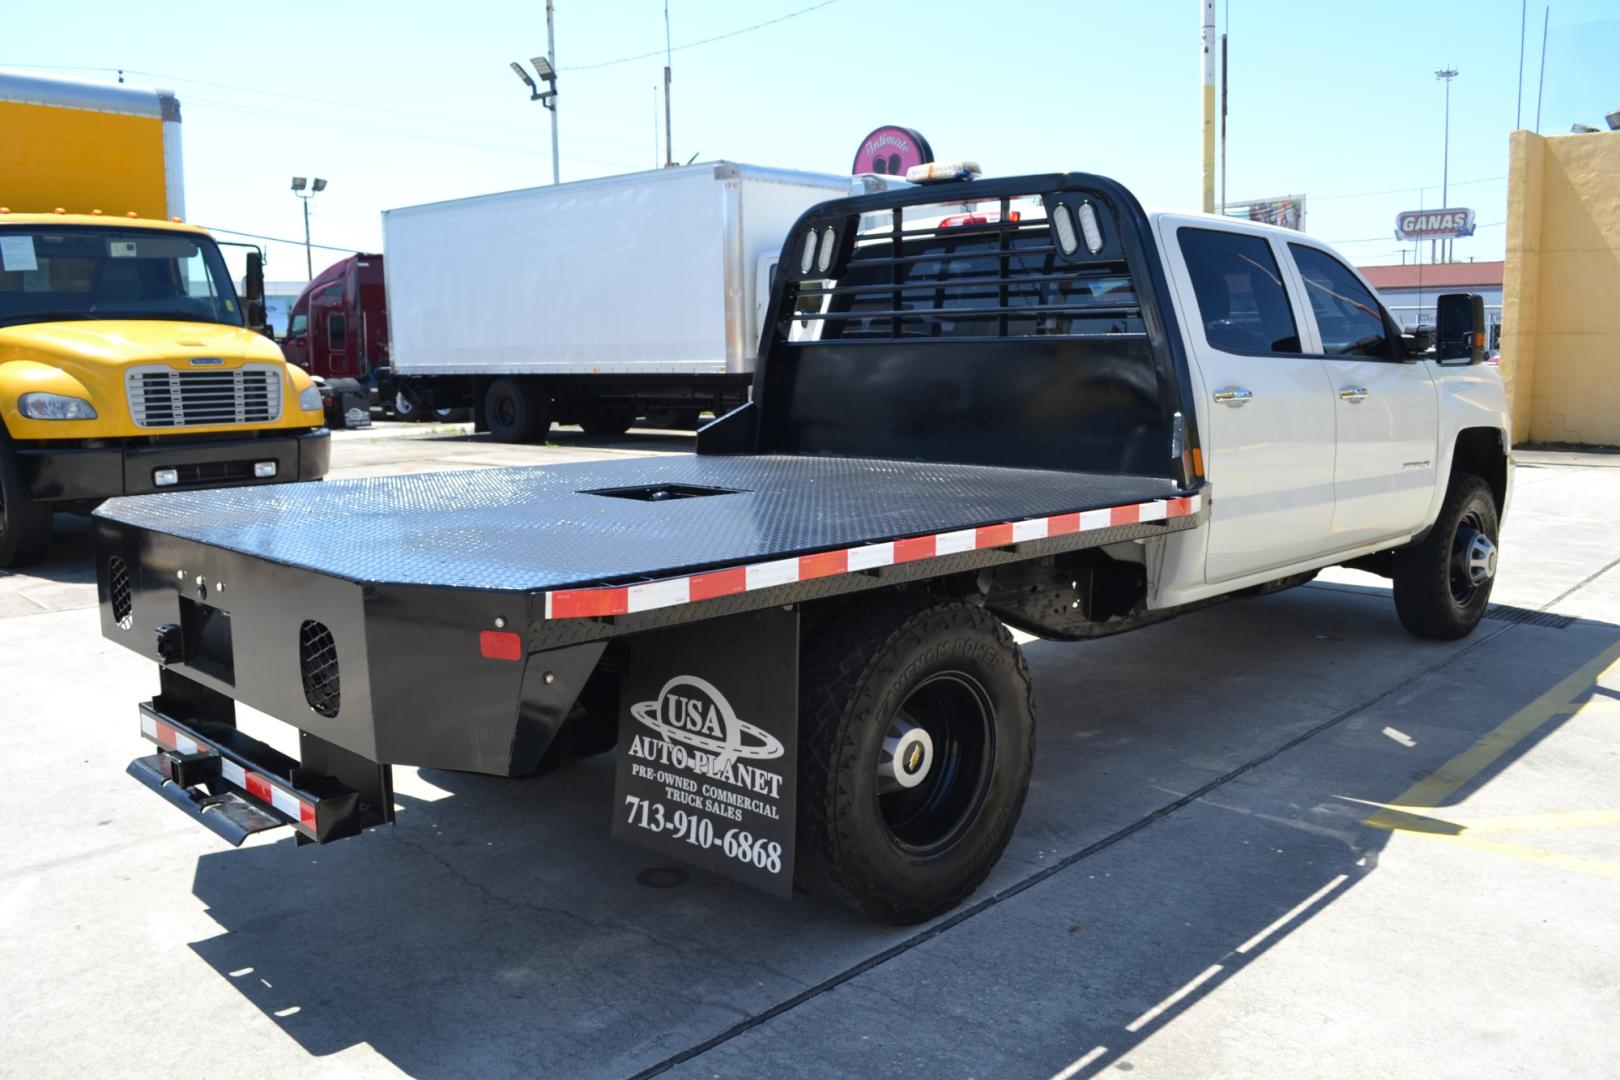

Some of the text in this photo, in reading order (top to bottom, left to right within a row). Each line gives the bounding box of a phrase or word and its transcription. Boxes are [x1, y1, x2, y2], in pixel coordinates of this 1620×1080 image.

[866, 134, 909, 156] Intimate
[1402, 213, 1465, 231] GANAS
[892, 638, 1004, 693] VENOM POWER
[667, 694, 724, 738] USA
[631, 764, 780, 820] PRE-OWNED COMMERCIAL
[665, 786, 743, 822] TRUCK SALES
[625, 794, 783, 874] 713-910-6868
